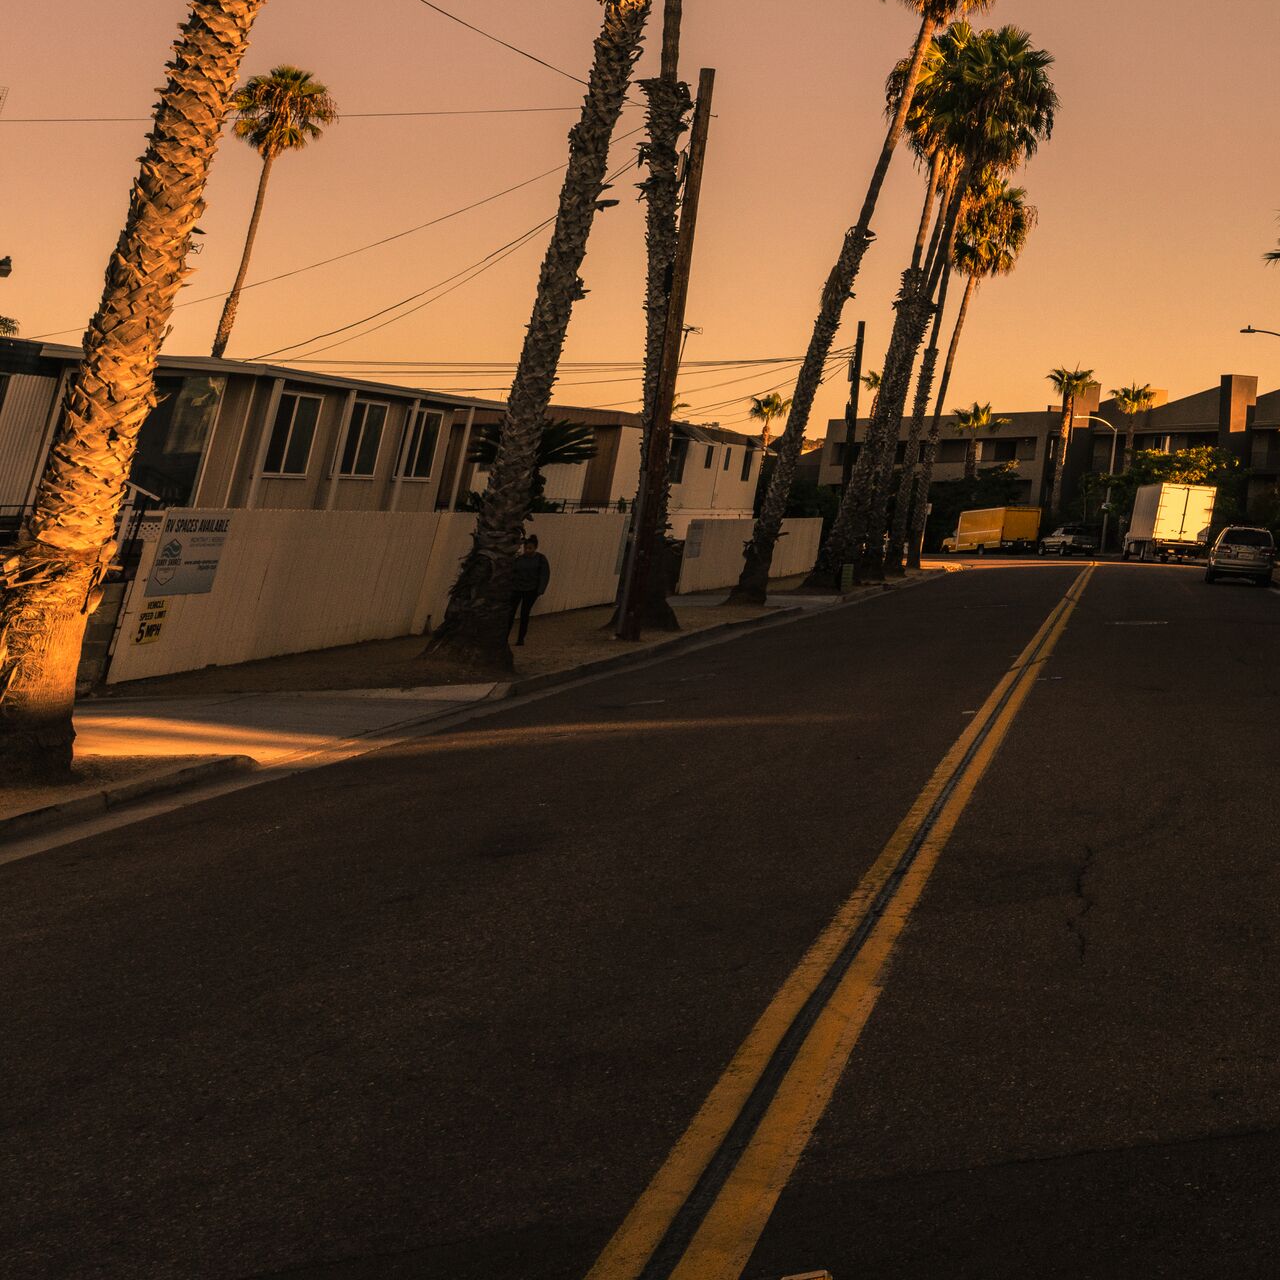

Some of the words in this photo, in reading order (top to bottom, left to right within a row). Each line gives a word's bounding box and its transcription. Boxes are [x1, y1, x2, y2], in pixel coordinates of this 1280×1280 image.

[174, 519, 200, 533] SPACES
[197, 519, 230, 533] AVAILABLE
[135, 622, 147, 643] 5
[144, 623, 162, 638] MPH
